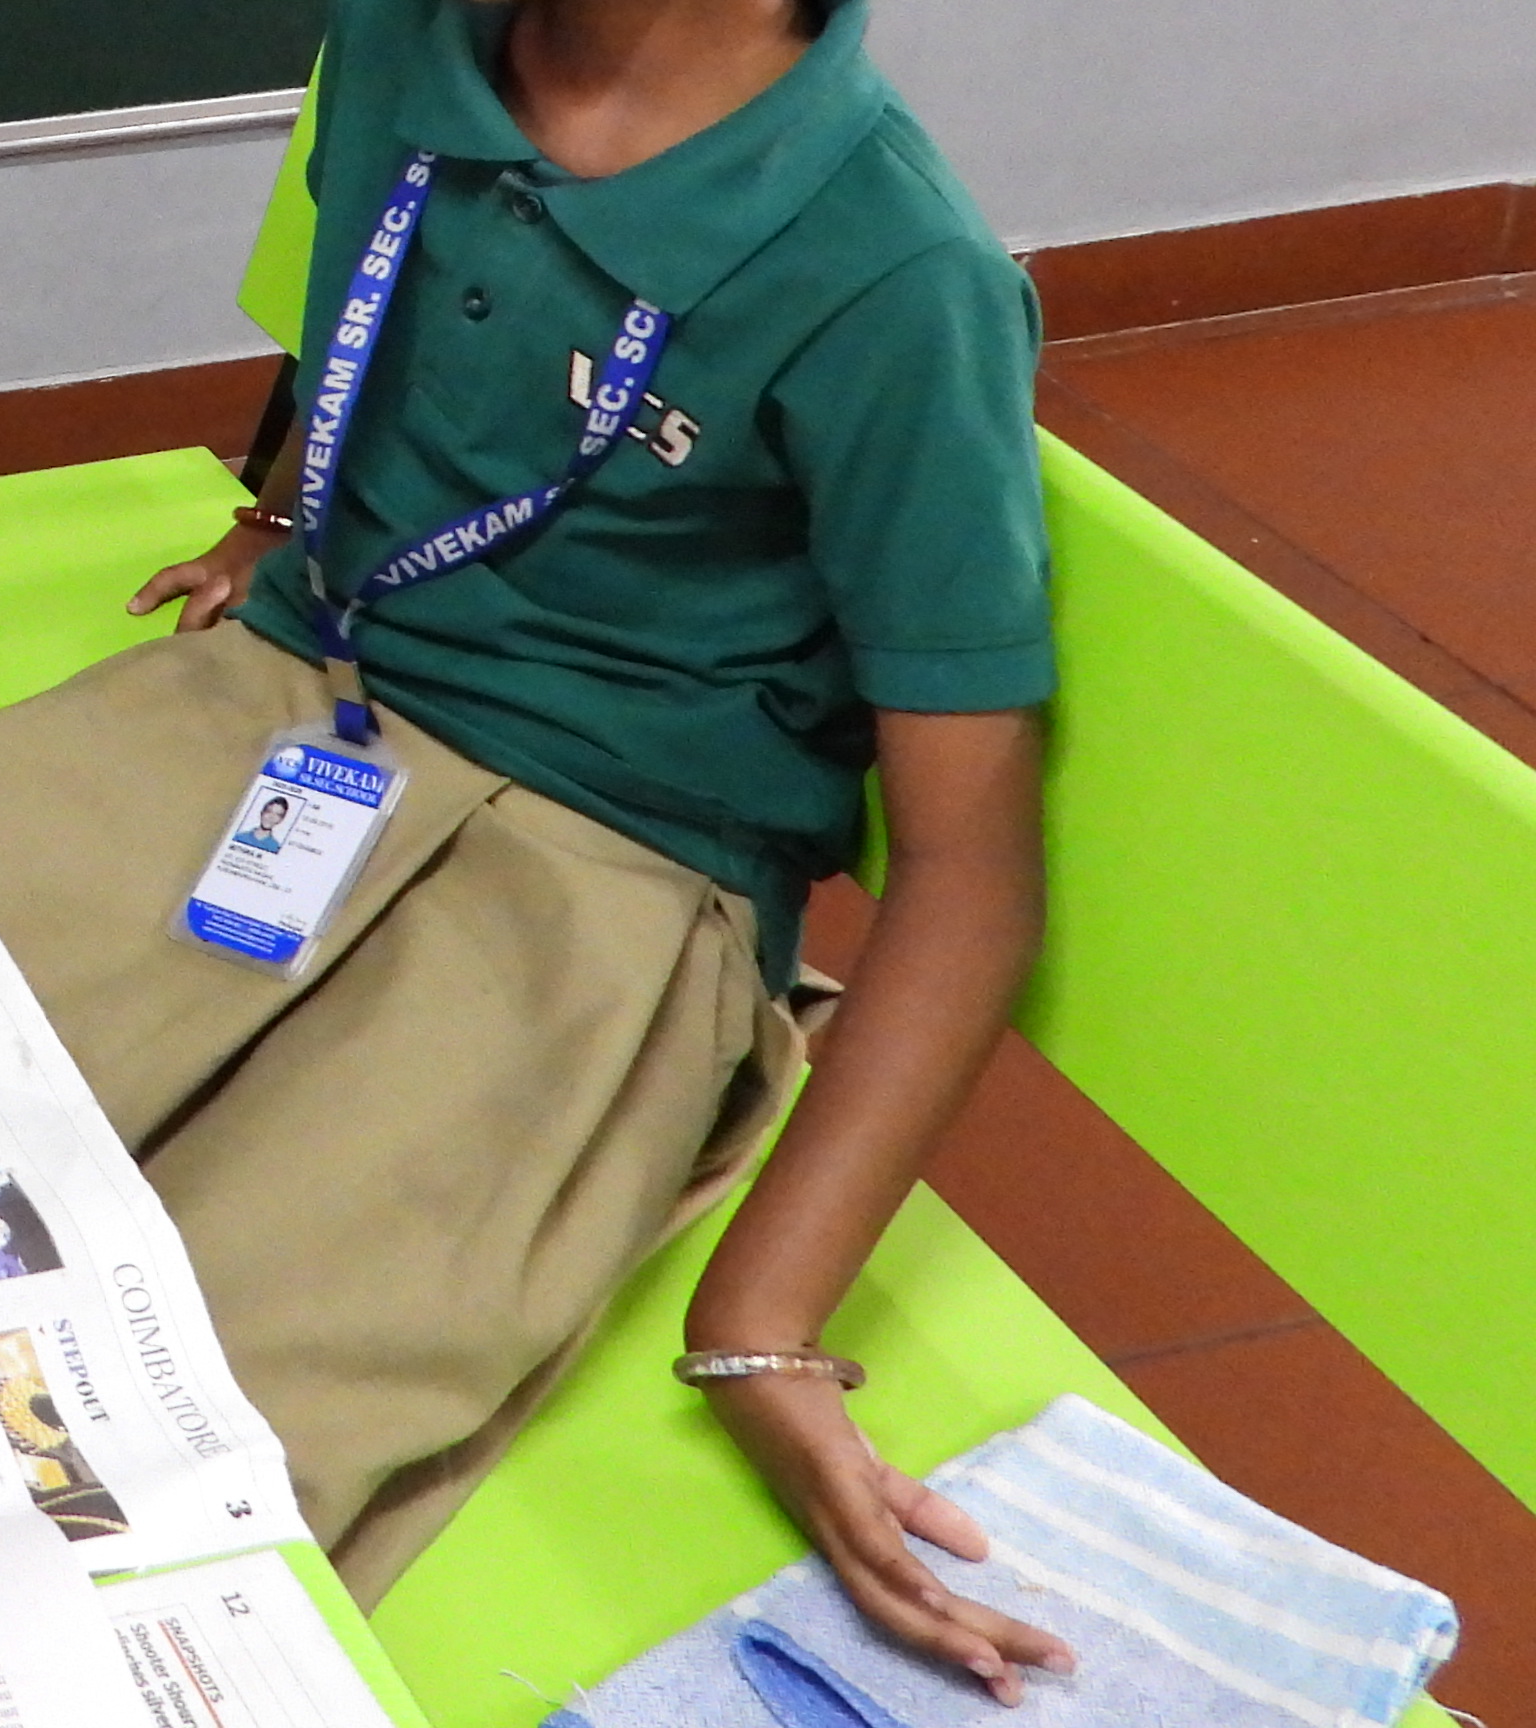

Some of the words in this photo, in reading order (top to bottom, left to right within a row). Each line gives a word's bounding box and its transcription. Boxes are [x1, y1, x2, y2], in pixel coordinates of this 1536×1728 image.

[302, 357, 358, 531] VIVEKAM
[337, 291, 382, 350] SR.
[362, 199, 417, 281] SEC.
[578, 376, 636, 456] SEC.
[374, 497, 534, 587] VIVEKAM
[113, 1263, 230, 1458] COIMBATORE
[129, 1622, 170, 1678] Shooter
[221, 1592, 250, 1618] 12
[164, 1616, 224, 1708] SNAPSHOTS
